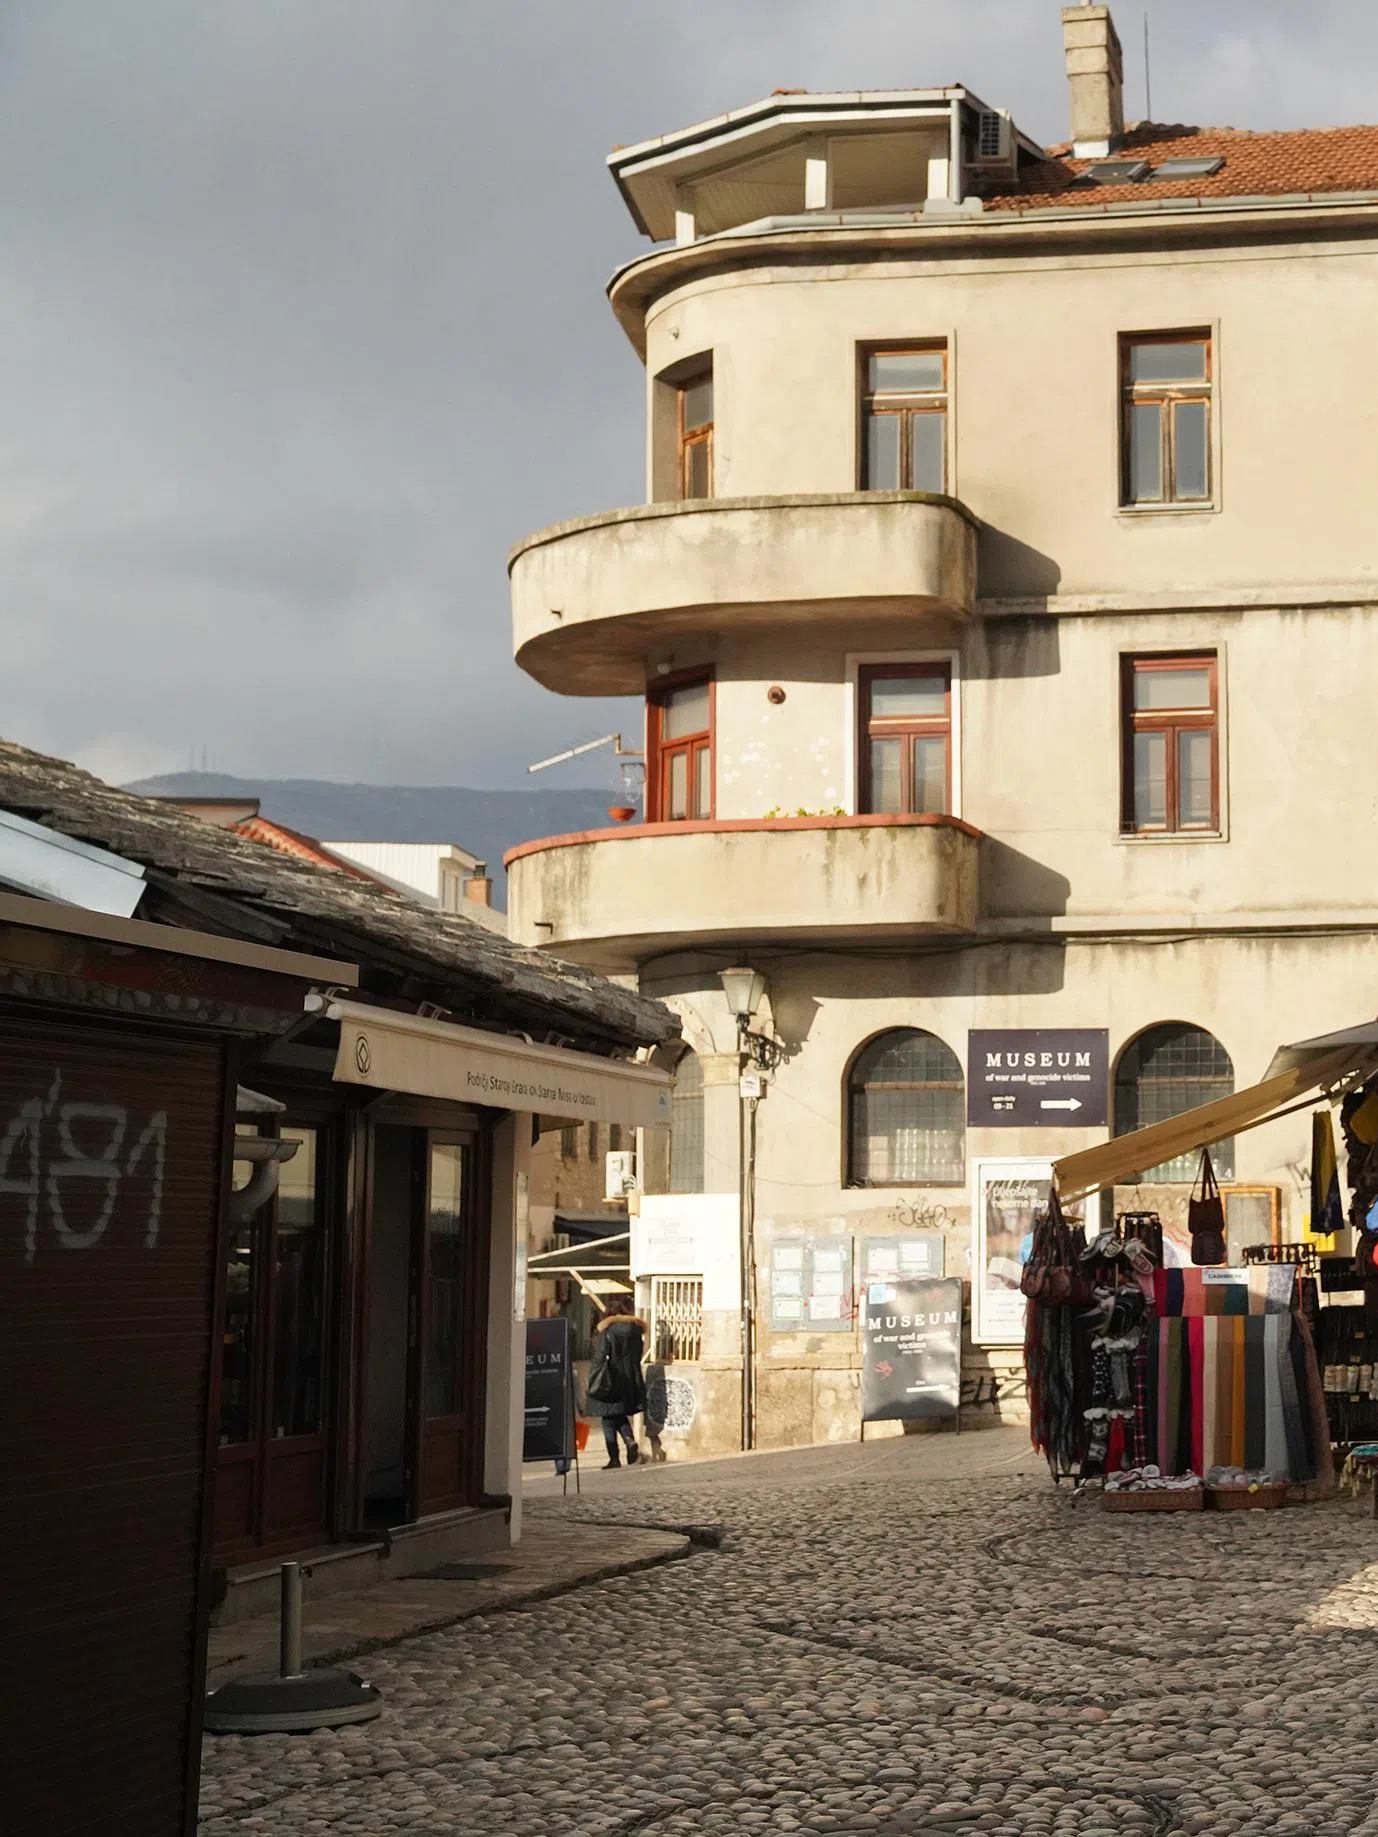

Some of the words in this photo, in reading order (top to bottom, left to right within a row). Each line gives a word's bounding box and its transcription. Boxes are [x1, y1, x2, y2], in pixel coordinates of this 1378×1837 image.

[986, 1052, 1091, 1067] MUSEUM
[985, 1073, 994, 1082] of
[995, 1074, 1010, 1082] war
[1010, 1073, 1026, 1082] and
[1062, 1073, 1091, 1082] victims
[868, 1311, 958, 1330] MUSEUM
[873, 1335, 883, 1343] of
[900, 1333, 915, 1342] and
[526, 1353, 561, 1365] EUM
